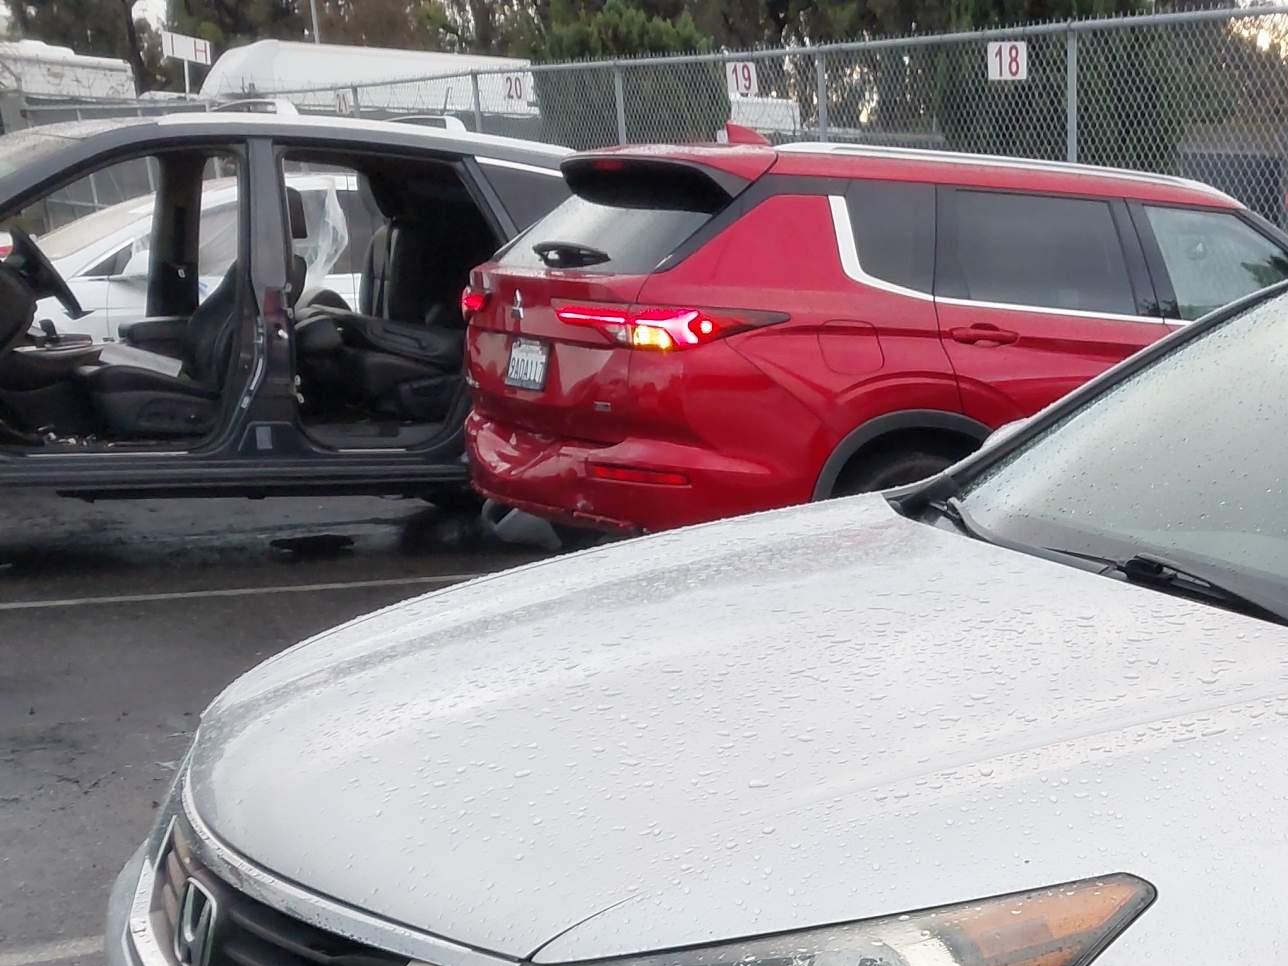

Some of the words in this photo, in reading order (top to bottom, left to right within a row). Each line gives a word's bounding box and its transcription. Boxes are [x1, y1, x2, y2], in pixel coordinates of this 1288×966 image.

[994, 44, 1020, 77] 18
[505, 76, 522, 100] 20
[731, 63, 752, 91] 19
